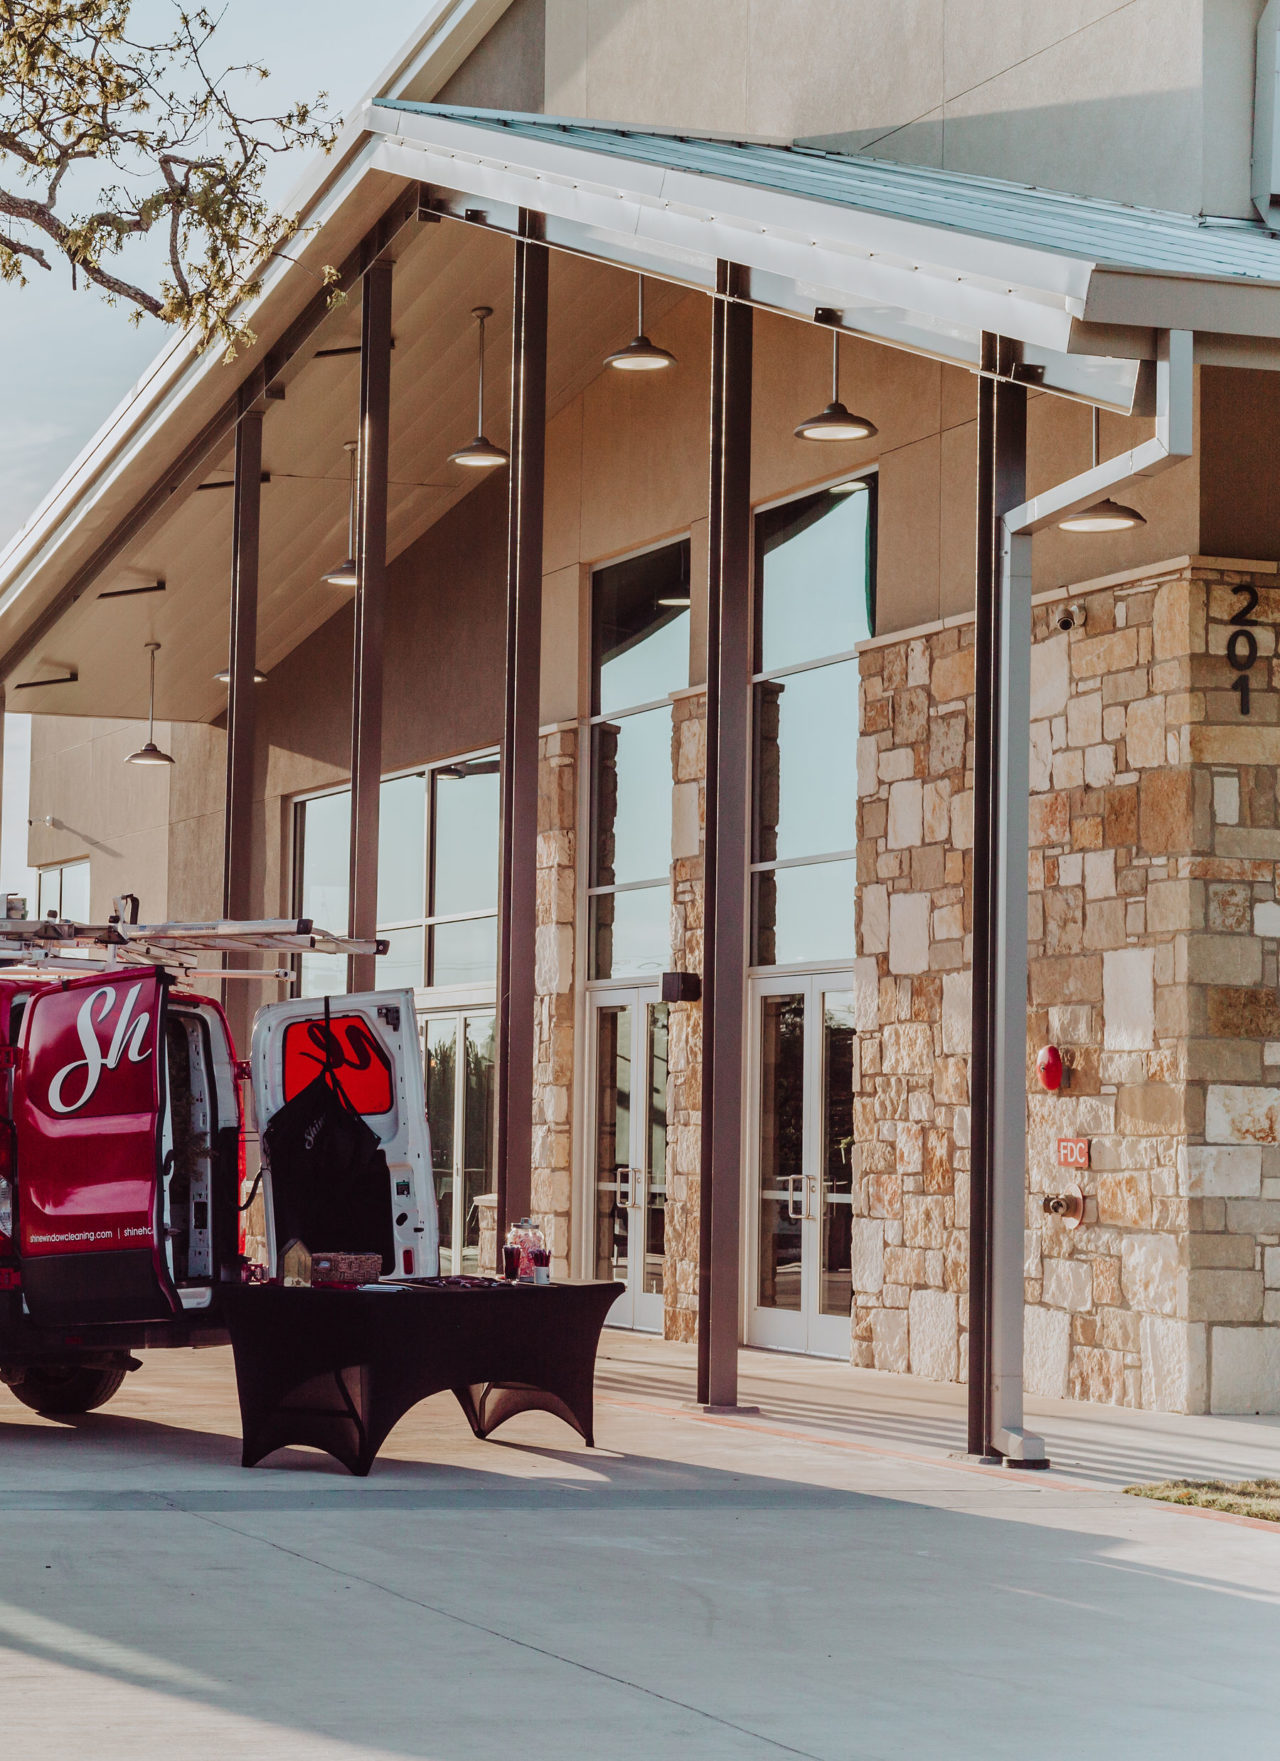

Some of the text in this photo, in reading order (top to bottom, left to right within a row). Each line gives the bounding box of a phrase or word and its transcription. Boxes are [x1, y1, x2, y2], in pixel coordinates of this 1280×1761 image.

[48, 982, 153, 1114] Sh
[1060, 1141, 1086, 1164] FDC
[30, 1230, 112, 1243] shinewindowcleaning.com
